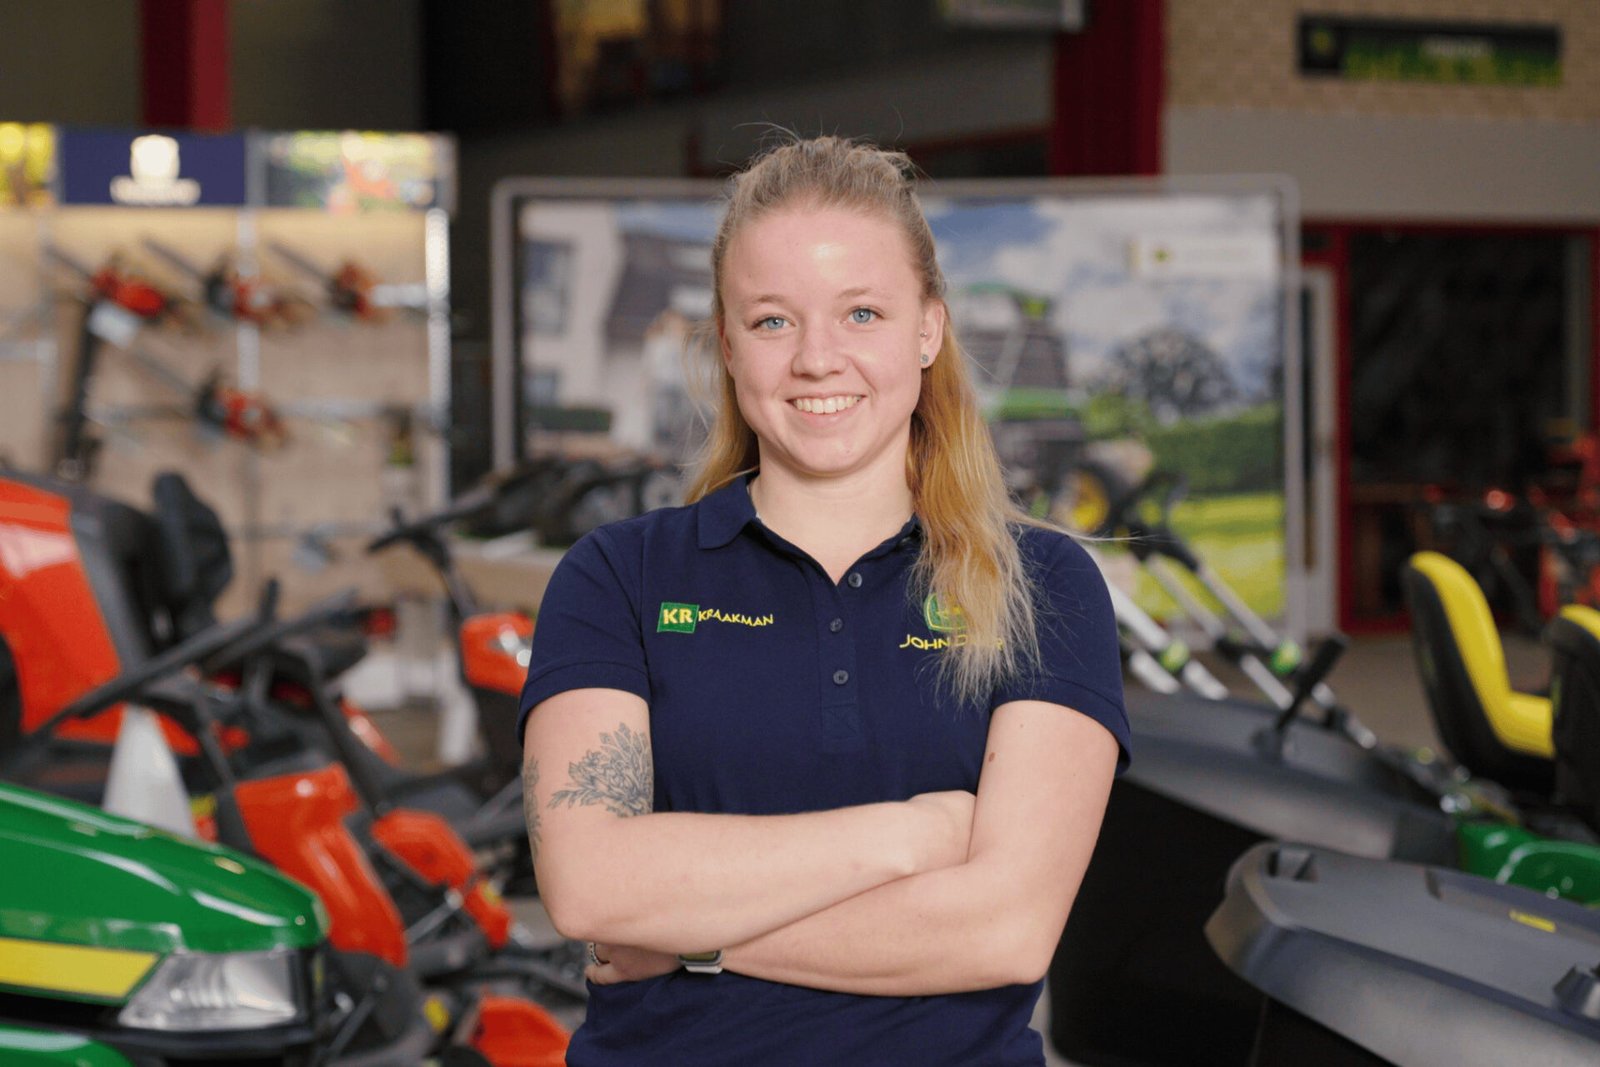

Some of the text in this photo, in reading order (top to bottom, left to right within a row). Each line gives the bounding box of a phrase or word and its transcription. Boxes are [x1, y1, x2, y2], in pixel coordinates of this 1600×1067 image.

[663, 608, 774, 627] KR KRAAKMAN
[899, 634, 950, 650] JOHN
